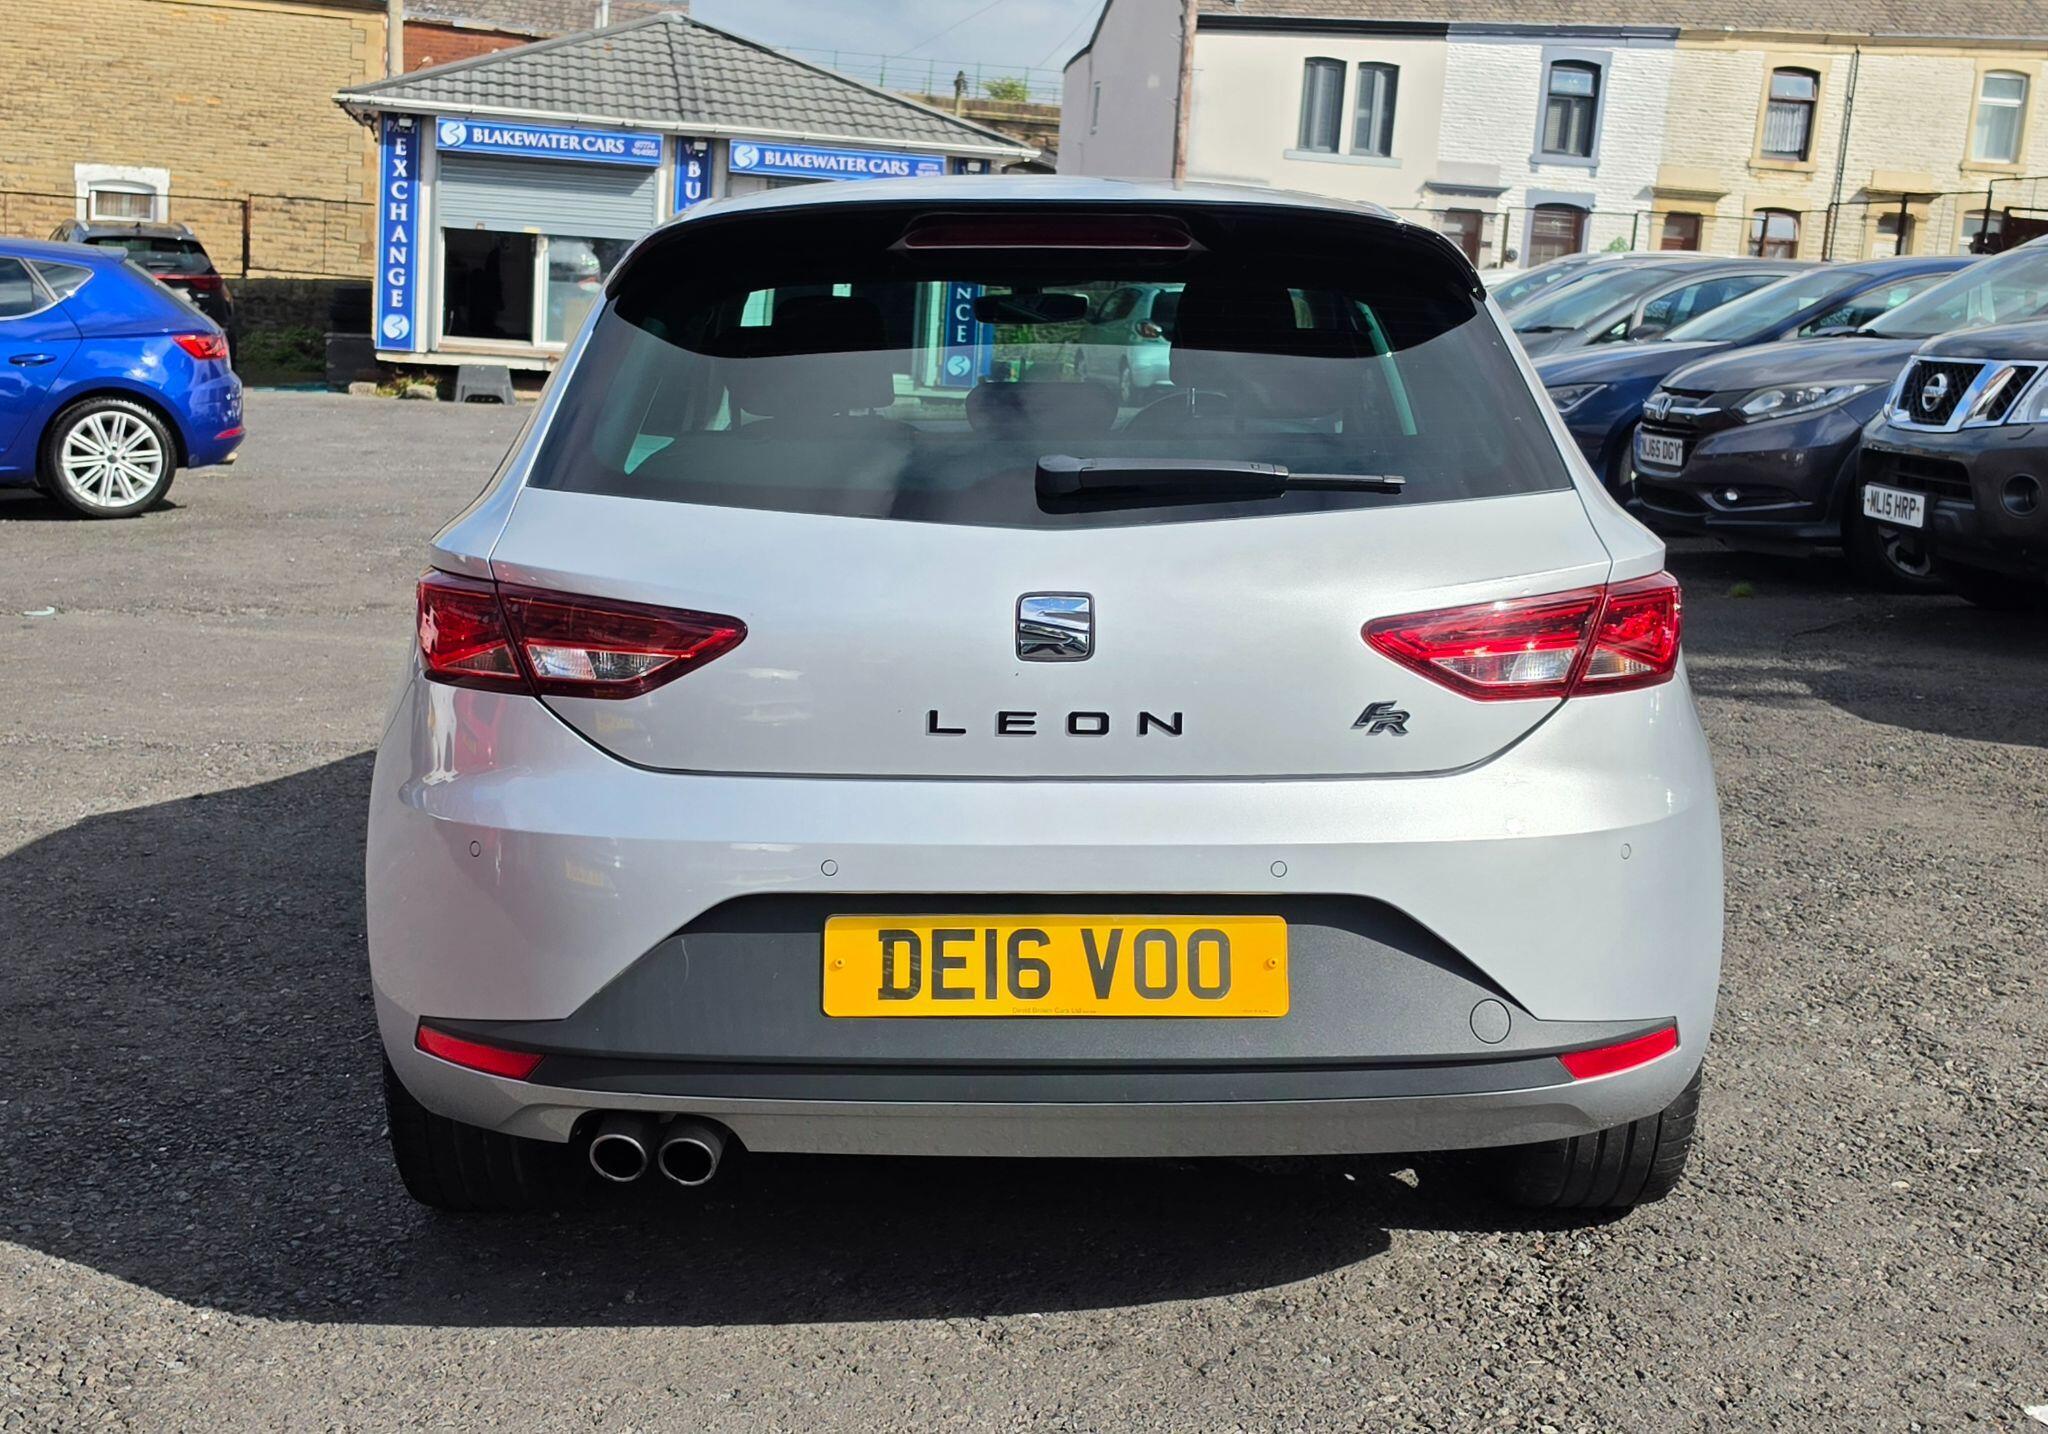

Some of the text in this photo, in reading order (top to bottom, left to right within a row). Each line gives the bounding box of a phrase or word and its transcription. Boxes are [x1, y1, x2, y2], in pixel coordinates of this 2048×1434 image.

[387, 120, 416, 134] PAT
[473, 128, 581, 150] BLAKEWATER
[582, 137, 625, 154] CARS
[764, 151, 867, 173] BLAKEWATER
[868, 159, 910, 176] CARS
[685, 161, 701, 207] BU
[388, 137, 409, 308] EXCHANGE
[1662, 440, 1682, 462] DGY
[1894, 494, 1917, 521] HRP
[928, 709, 1183, 736] LEON
[1351, 700, 1411, 736] FR
[878, 928, 1051, 1000] DE16
